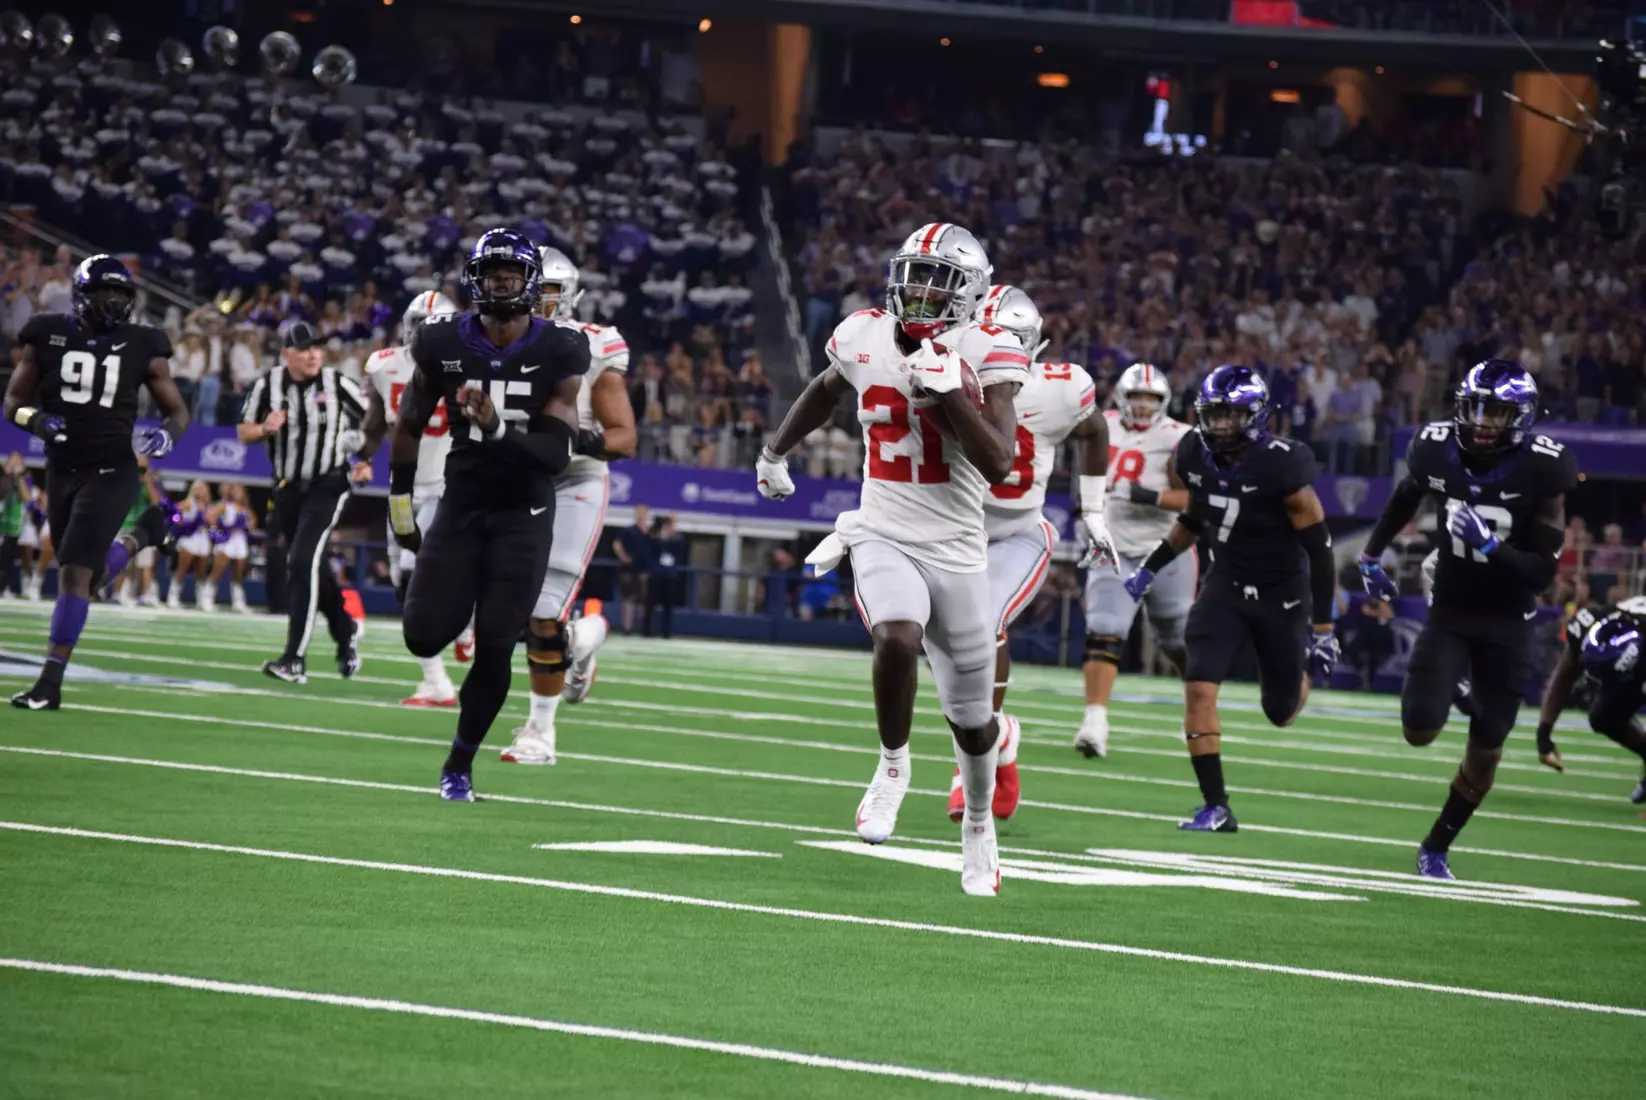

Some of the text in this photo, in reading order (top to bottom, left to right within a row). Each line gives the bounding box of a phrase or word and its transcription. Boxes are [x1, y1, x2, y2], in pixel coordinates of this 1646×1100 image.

[60, 350, 121, 408] 91
[862, 384, 951, 484] 21
[1531, 434, 1565, 458] 12
[1208, 493, 1240, 543] 7
